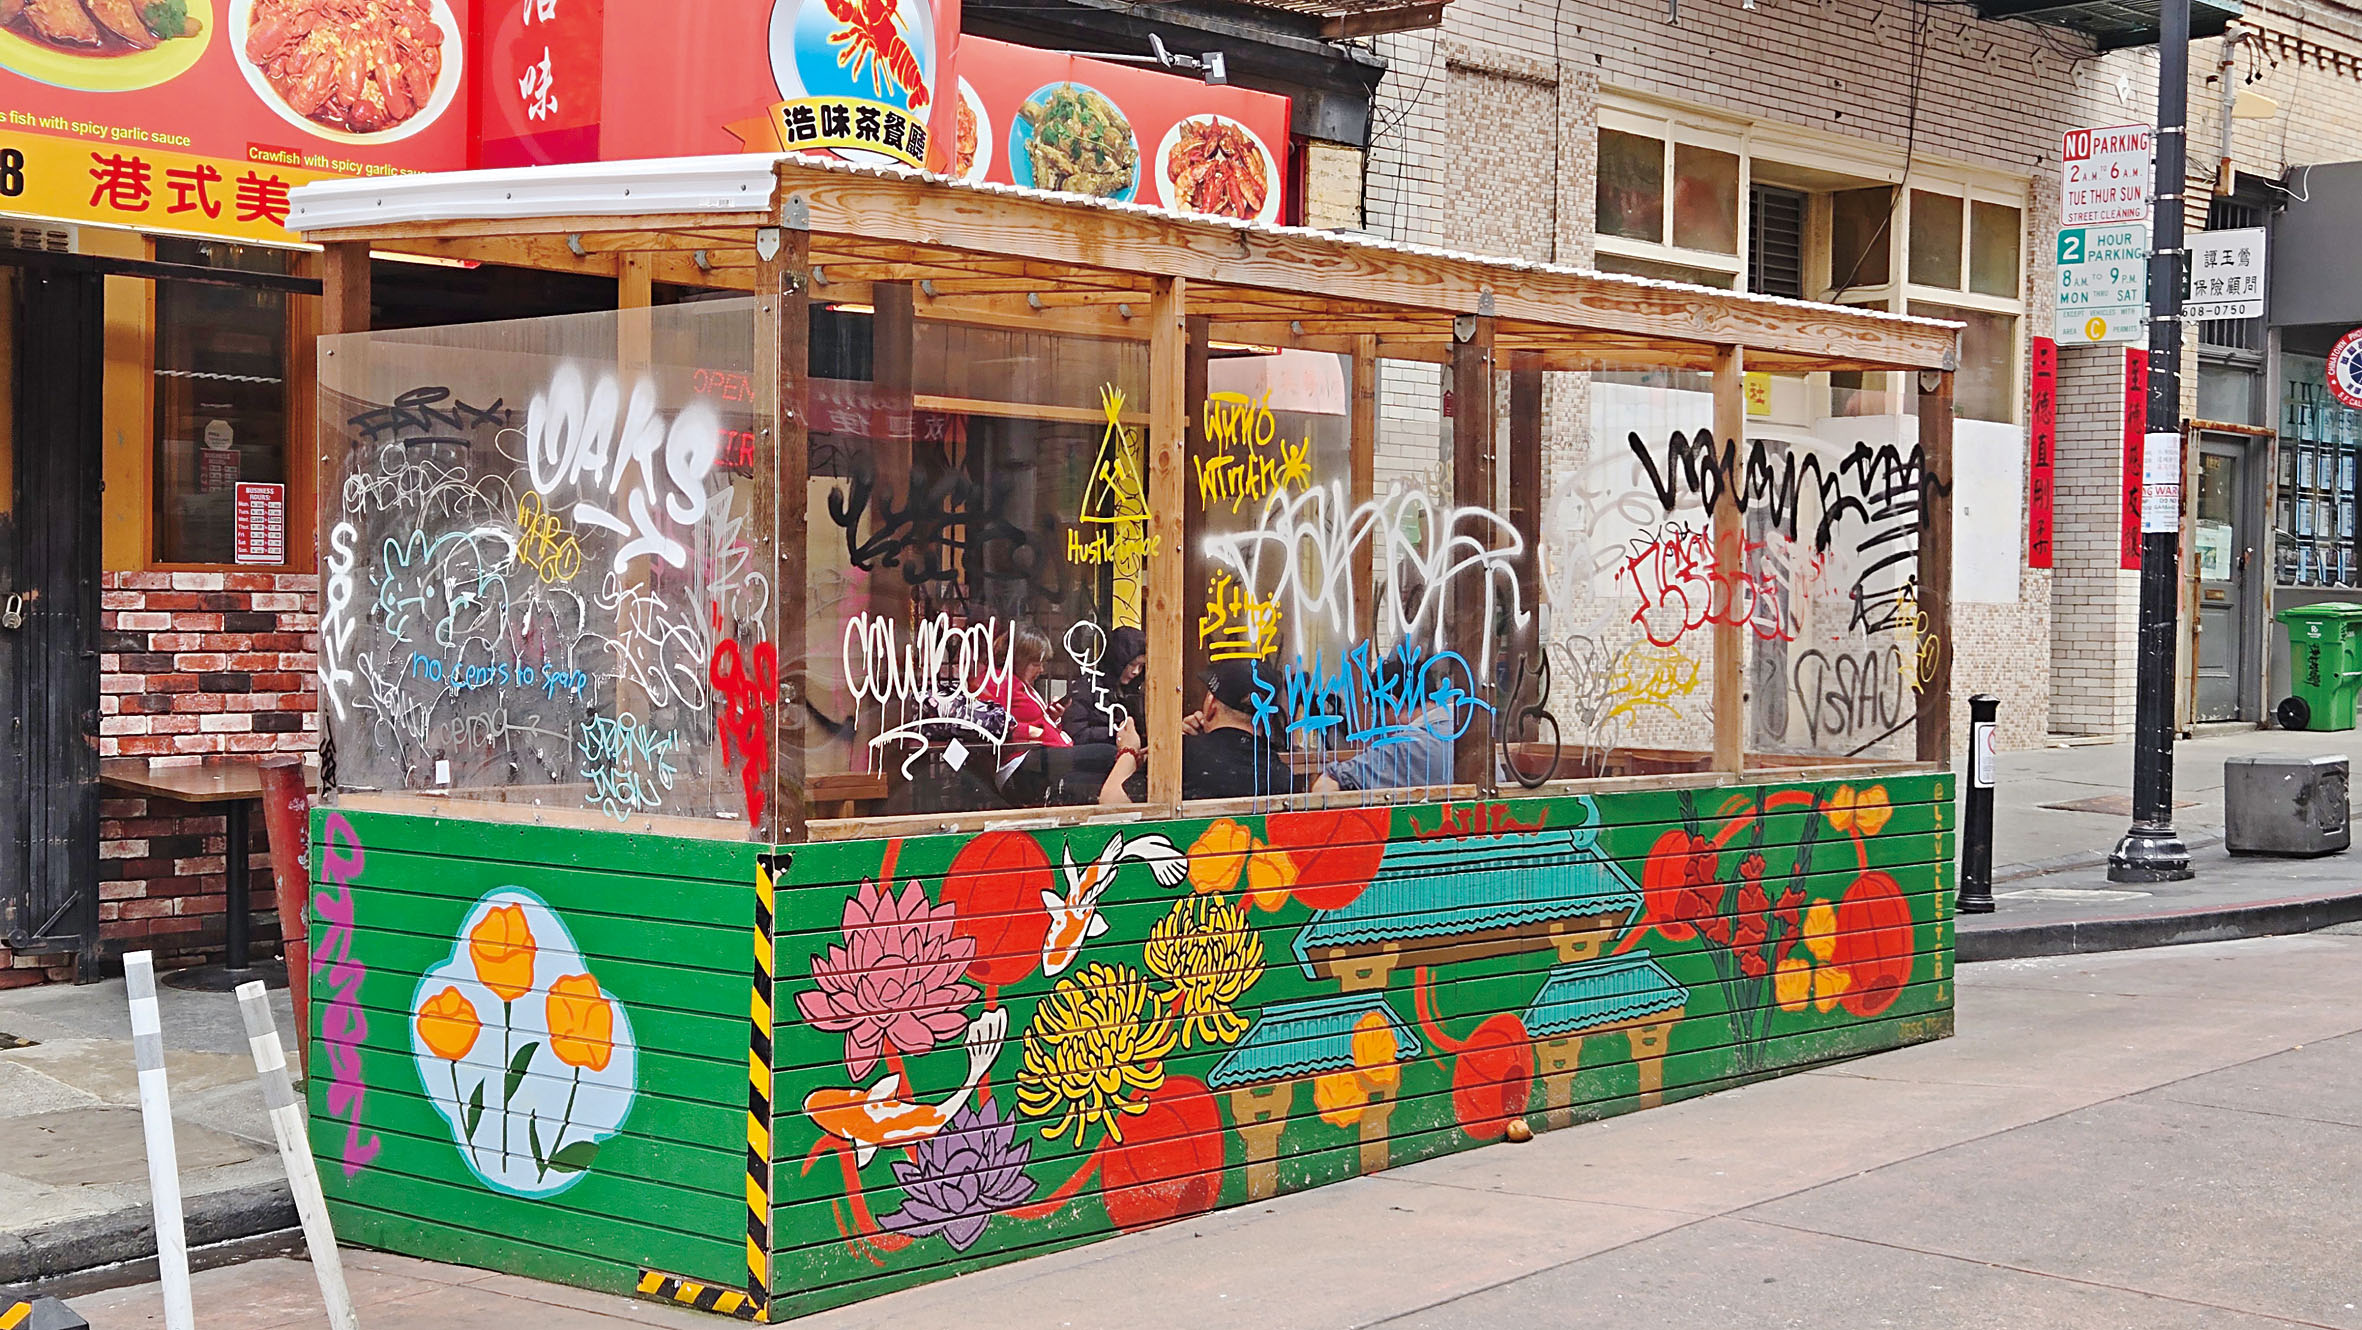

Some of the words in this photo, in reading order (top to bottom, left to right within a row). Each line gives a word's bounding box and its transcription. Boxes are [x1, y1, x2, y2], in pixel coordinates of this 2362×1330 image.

[10, 110, 36, 127] fish
[39, 115, 69, 131] with
[71, 121, 109, 139] spicy
[111, 126, 149, 142] garlic
[151, 132, 191, 147] sauce
[783, 103, 928, 162] 浩味茶餐廳
[2065, 132, 2089, 159] NO
[2093, 132, 2148, 155] PARKING
[249, 147, 301, 165] Crawfish
[304, 155, 329, 169] with
[331, 158, 363, 176] spicy
[366, 163, 398, 177] garlic
[2070, 164, 2080, 183] 2
[2110, 161, 2120, 179] 6
[88, 151, 292, 227] 港式美
[2069, 190, 2087, 206] TUE
[2090, 187, 2117, 203] THUR
[2120, 186, 2141, 202] SUN
[2068, 210, 2098, 223] STREET
[2100, 207, 2141, 219] CLEANING
[2062, 236, 2080, 260] 2
[2097, 233, 2132, 247] HOUR
[2088, 247, 2142, 262] PARKING
[2062, 269, 2072, 287] 8
[2092, 273, 2103, 281] TO
[2109, 267, 2120, 285] 9
[2193, 275, 2258, 297] 保險顧問
[2060, 291, 2089, 304] MON
[2117, 289, 2138, 302] SAT
[2062, 327, 2077, 335] AREA
[2089, 319, 2101, 338] C
[412, 650, 443, 683] no
[450, 661, 510, 691] cents
[515, 658, 535, 687] to
